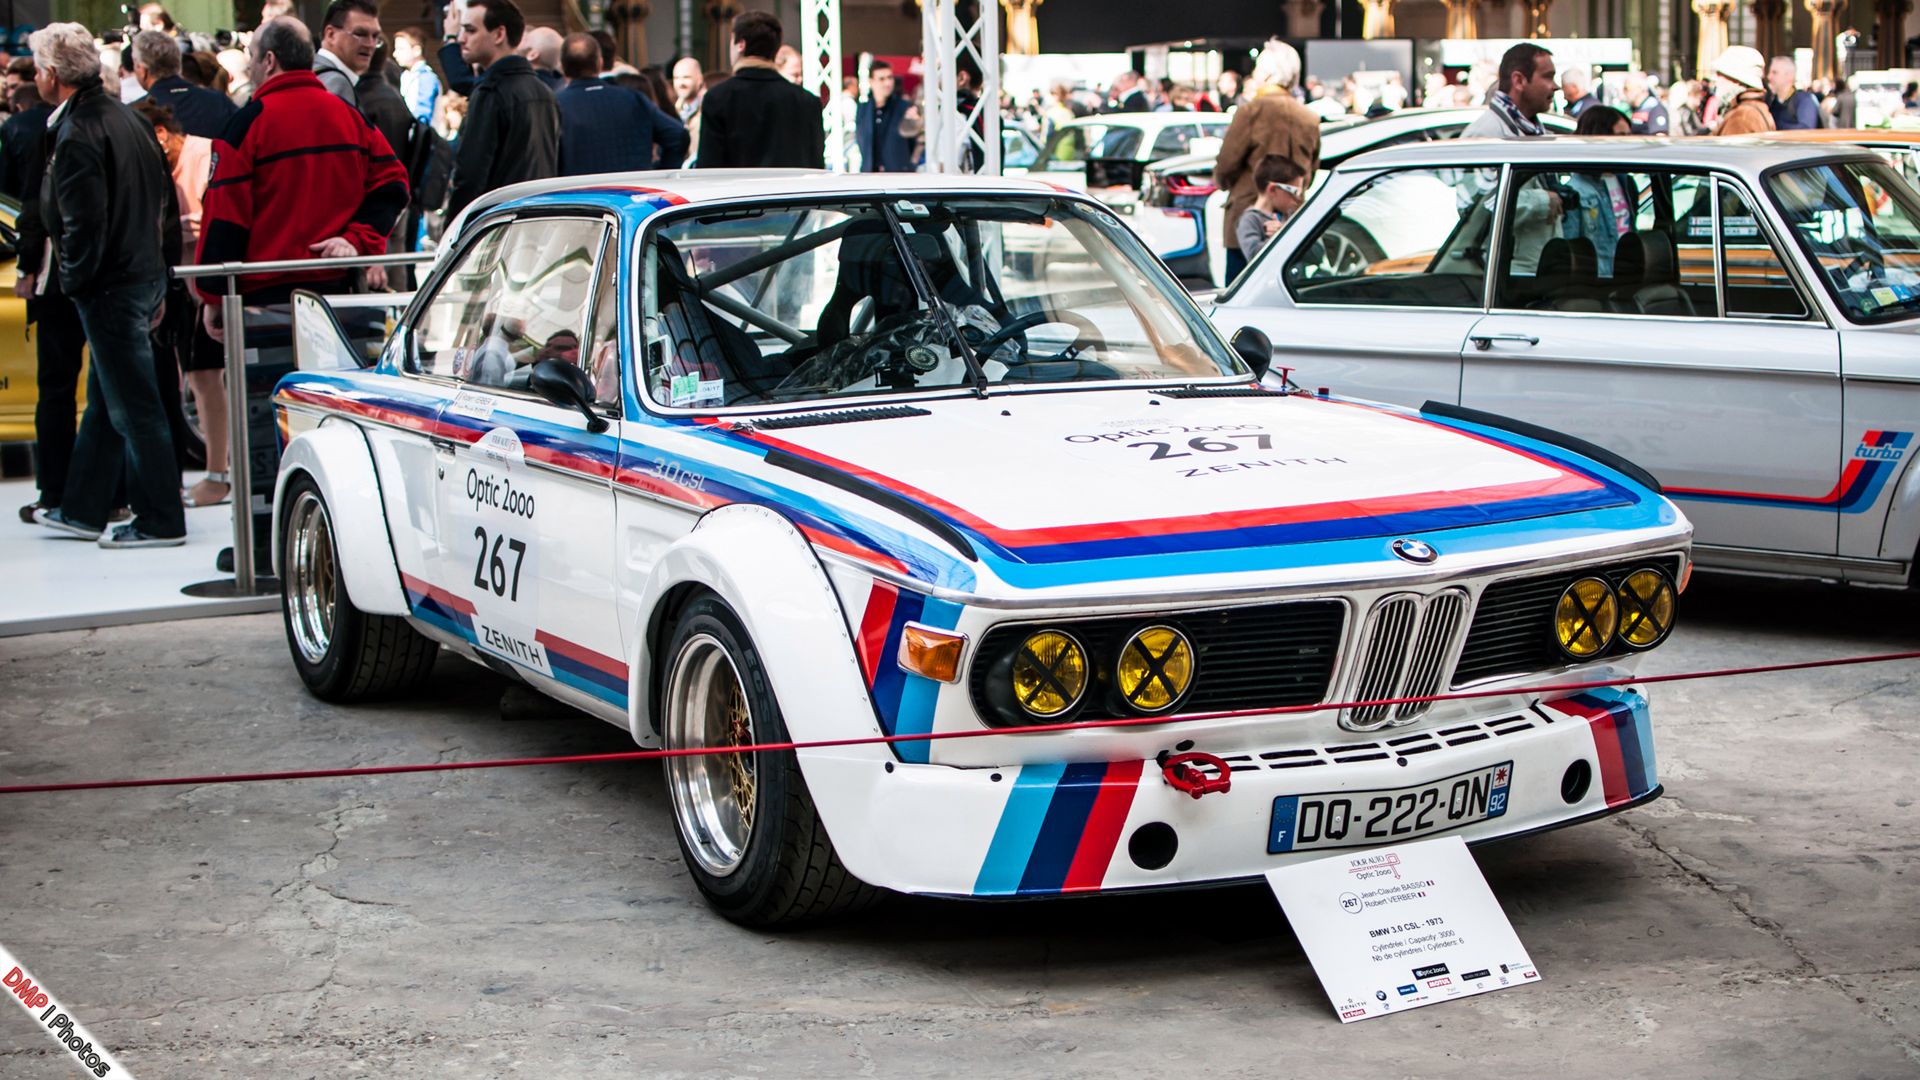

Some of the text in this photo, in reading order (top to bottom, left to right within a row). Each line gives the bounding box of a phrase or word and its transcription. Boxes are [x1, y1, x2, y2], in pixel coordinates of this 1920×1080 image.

[1064, 428, 1170, 443] Optic
[1126, 433, 1273, 461] 267
[1854, 442, 1904, 460] turbo
[1175, 456, 1349, 478] ZENITH
[466, 467, 500, 513] Optic
[679, 470, 706, 492] CSL
[474, 525, 527, 602] 267
[481, 624, 543, 668] ZENITH
[1297, 772, 1492, 844] DQ-222-QN
[1489, 792, 1507, 812] 92
[1277, 830, 1287, 843] F
[1350, 858, 1368, 867] TOUR
[1368, 855, 1385, 865] AUTO
[1356, 872, 1375, 880] Optic
[1361, 880, 1426, 899] Jean-Claude BASSO
[1342, 898, 1358, 908] 267
[1364, 892, 1417, 908] Robert VERBER
[1369, 927, 1390, 938] BMW
[1390, 925, 1403, 933] 3.0
[1403, 921, 1421, 931] CSL
[1425, 917, 1444, 927] 1973
[1372, 940, 1404, 952] Cylindrée
[1438, 929, 1456, 939] 3000
[1371, 954, 1383, 962] Nb
[1383, 952, 1393, 960] de
[1393, 946, 1423, 958] cylindres
[1340, 1001, 1367, 1011] ZENITH
